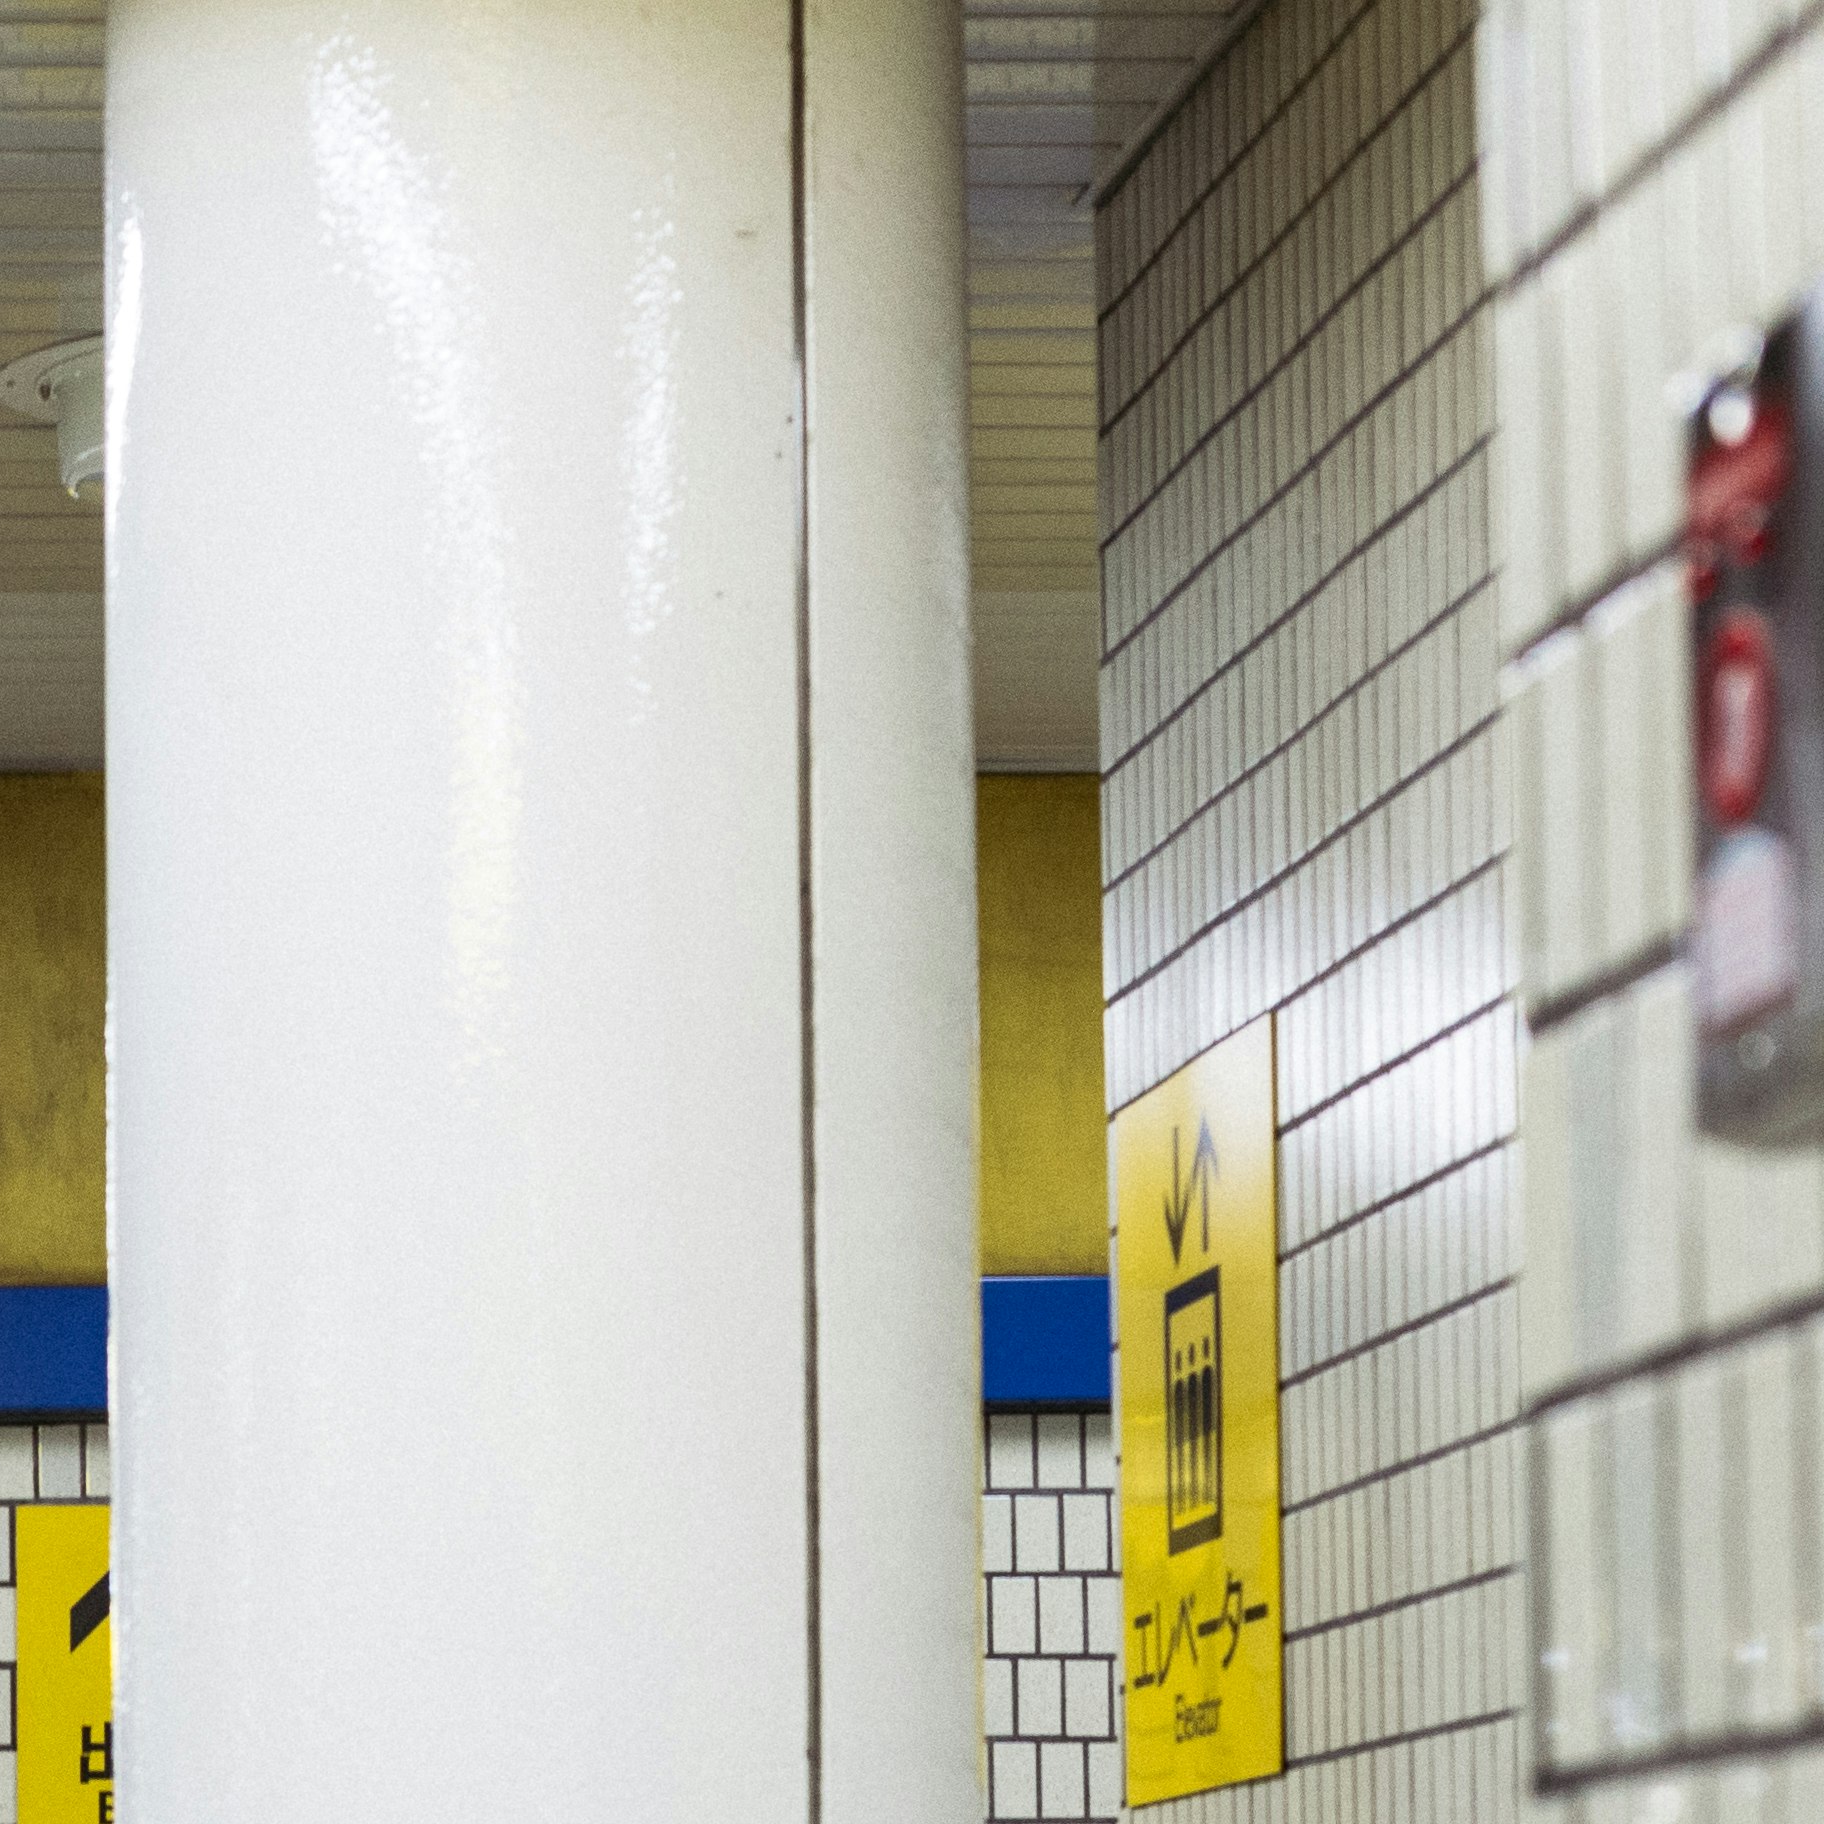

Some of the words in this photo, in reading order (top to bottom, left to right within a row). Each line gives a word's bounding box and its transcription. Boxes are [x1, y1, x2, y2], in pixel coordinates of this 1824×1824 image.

[1134, 1570, 1269, 1690] エレベーター
